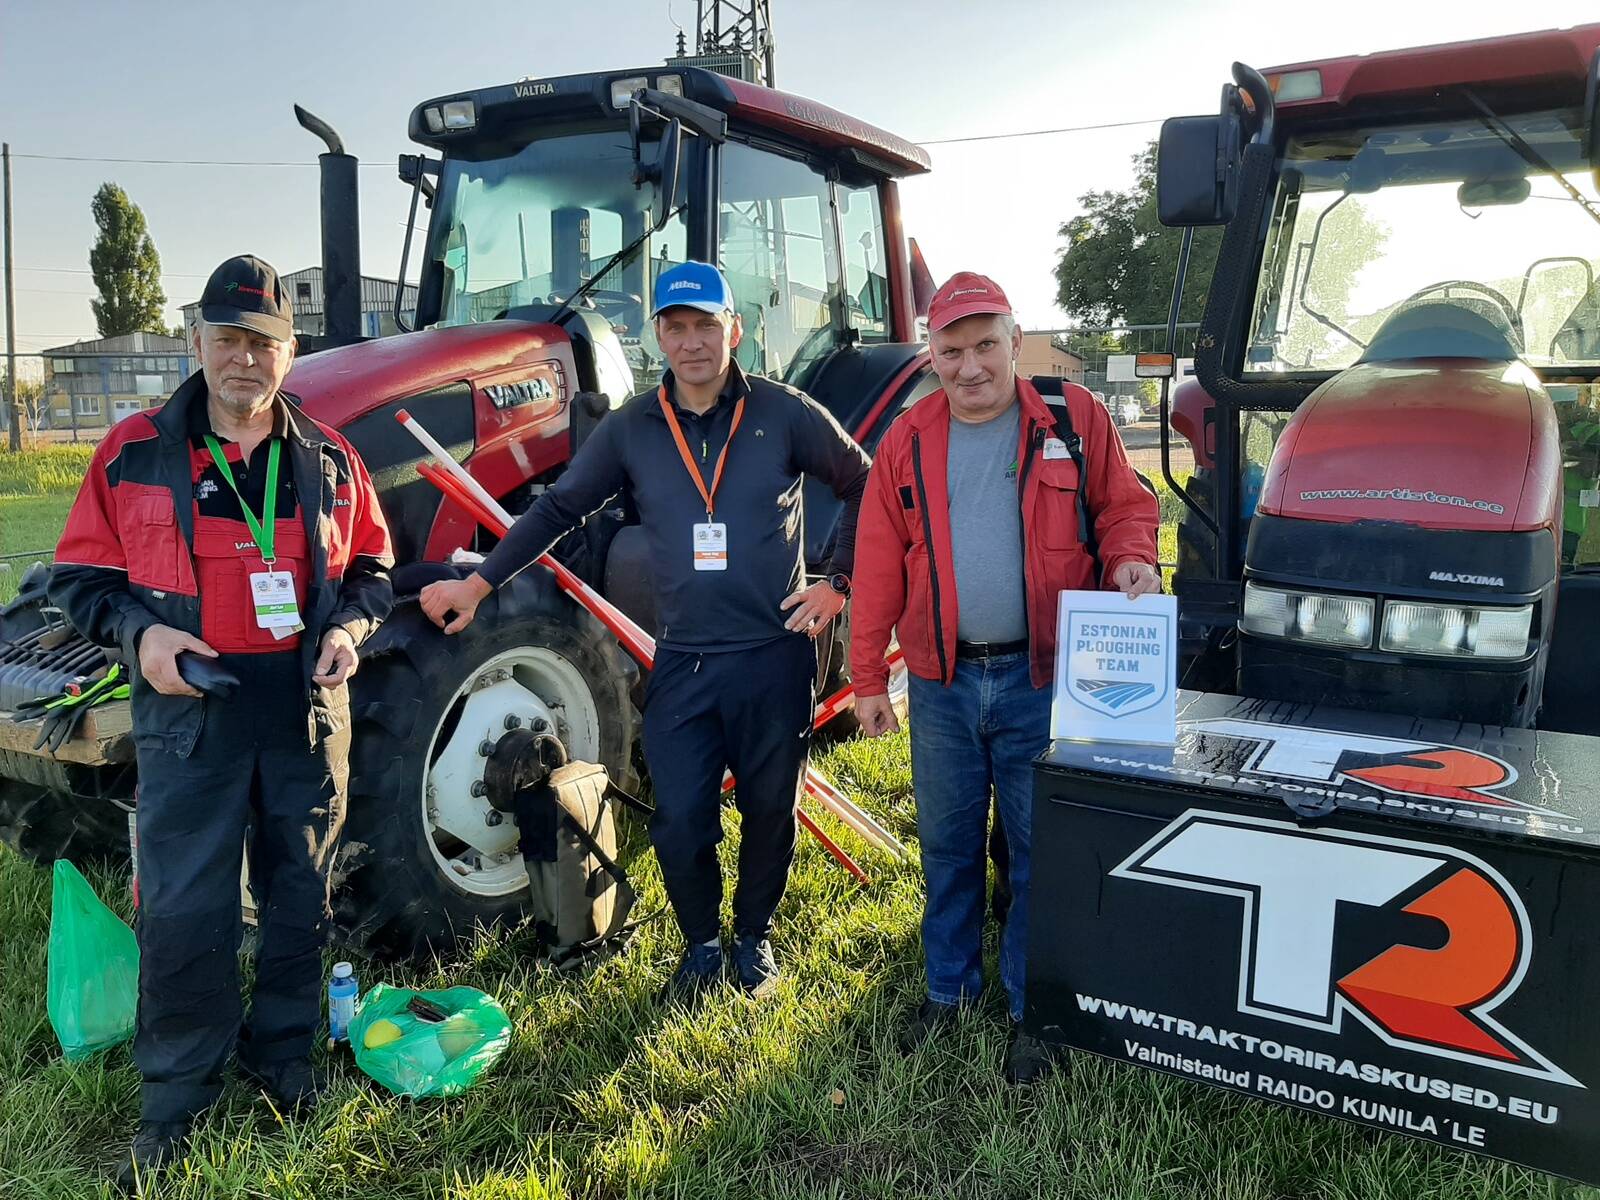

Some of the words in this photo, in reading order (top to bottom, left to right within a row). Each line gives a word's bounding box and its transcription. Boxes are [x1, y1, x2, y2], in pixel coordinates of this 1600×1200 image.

[513, 83, 554, 98] VALTRA
[484, 377, 553, 409] VALTRA
[1300, 488, 1505, 515] www.artiston.ee
[1429, 570, 1505, 587] MAXXIMA
[1081, 624, 1157, 639] ESTONIAN
[1076, 640, 1160, 656] PLOUGHING
[1095, 658, 1140, 672] TEAM
[1075, 993, 1558, 1124] WWW.TRAKTORIRASKUSED.EU
[1124, 1039, 1250, 1088] Valmistatud
[1257, 1074, 1335, 1109] RAIDO
